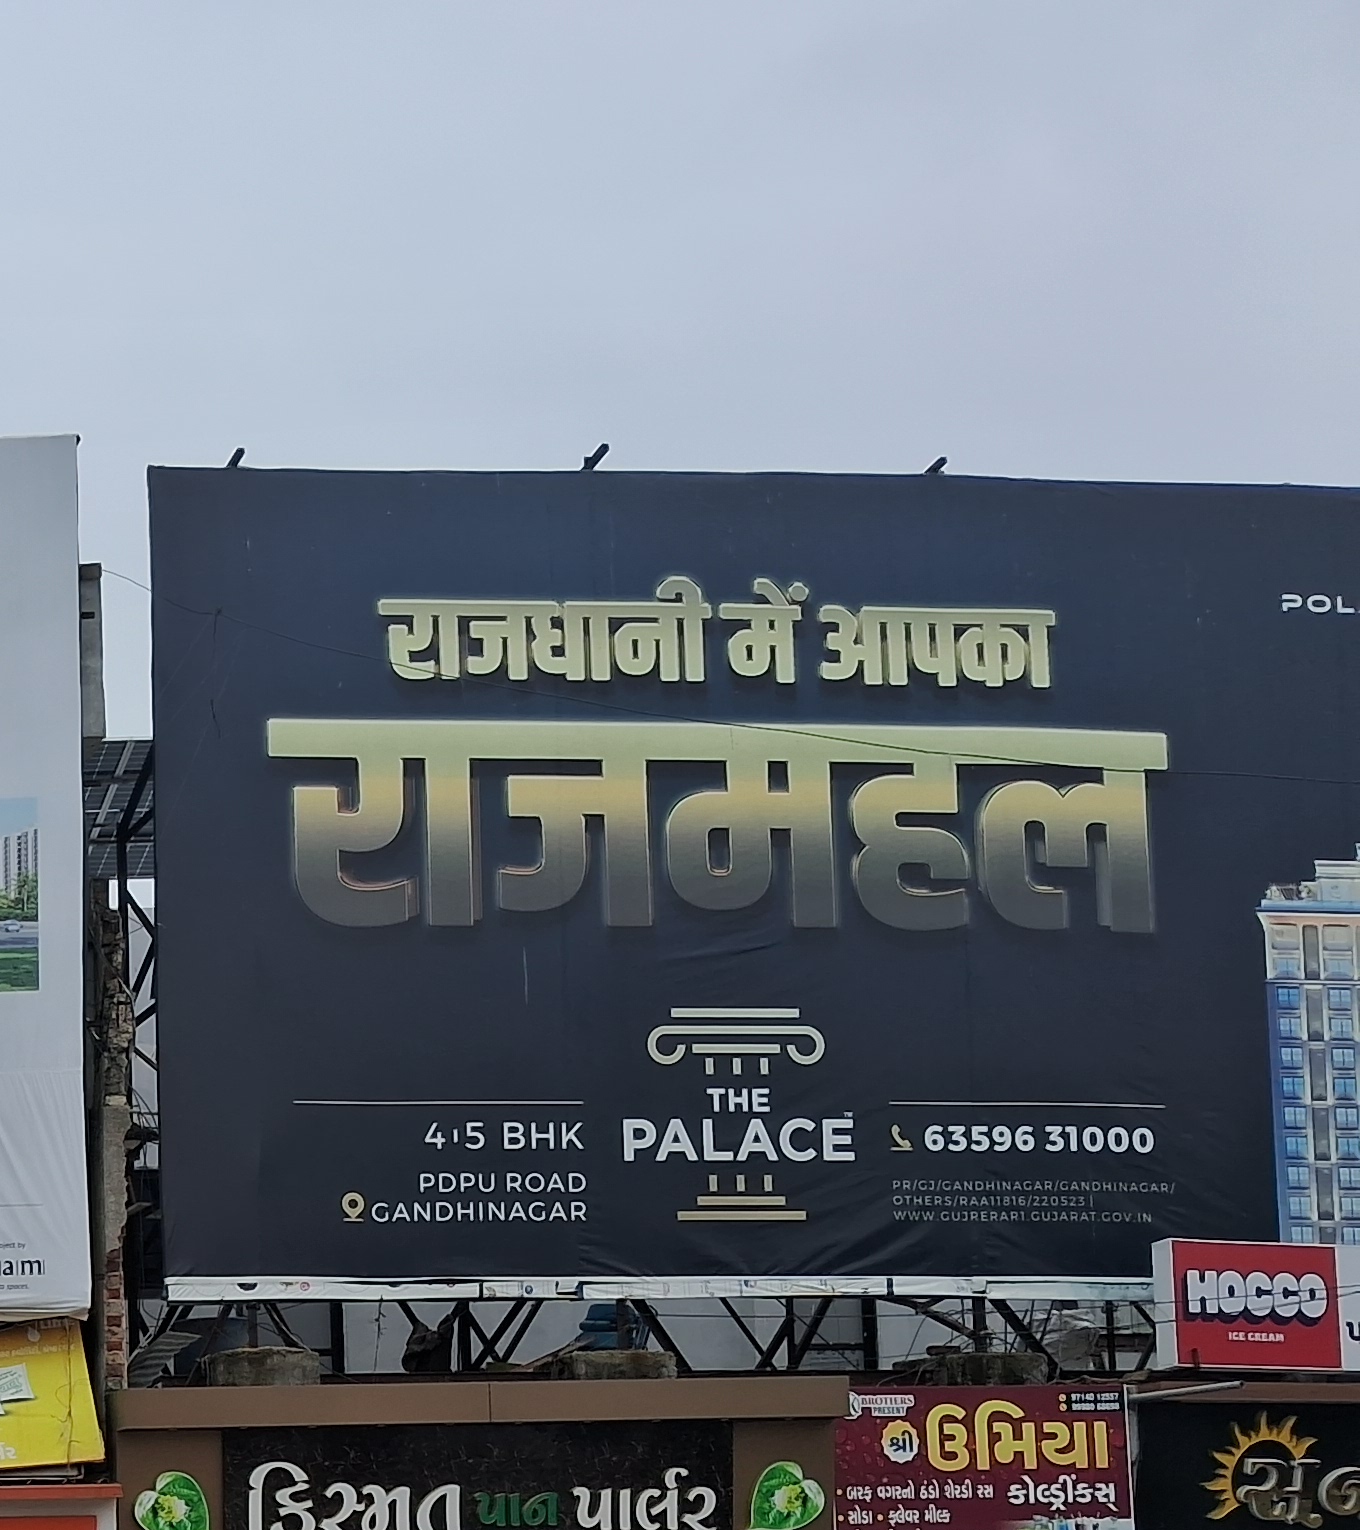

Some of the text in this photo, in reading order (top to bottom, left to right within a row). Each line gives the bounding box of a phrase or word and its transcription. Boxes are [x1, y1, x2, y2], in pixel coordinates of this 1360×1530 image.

[1281, 594, 1360, 613] POL
[377, 576, 1055, 688] राजधानी में आपका
[267, 716, 1168, 934] राजमहल
[706, 1088, 770, 1113] THE
[503, 1121, 584, 1150] BHK
[622, 1117, 856, 1162] PALACE
[924, 1125, 1154, 1154] 63596 31000
[419, 1173, 587, 1193] PDPU ROAD
[371, 1201, 587, 1223] GANDHINAGAR
[1185, 1269, 1327, 1321] HOCCO
[1228, 1331, 1284, 1342] ICE CREAM
[888, 1436, 914, 1454] શ્રી
[927, 1400, 1109, 1472] ઉમિયા
[846, 1485, 873, 1502] બરફ
[976, 1484, 993, 1498] રસ
[476, 1491, 558, 1528] પાન
